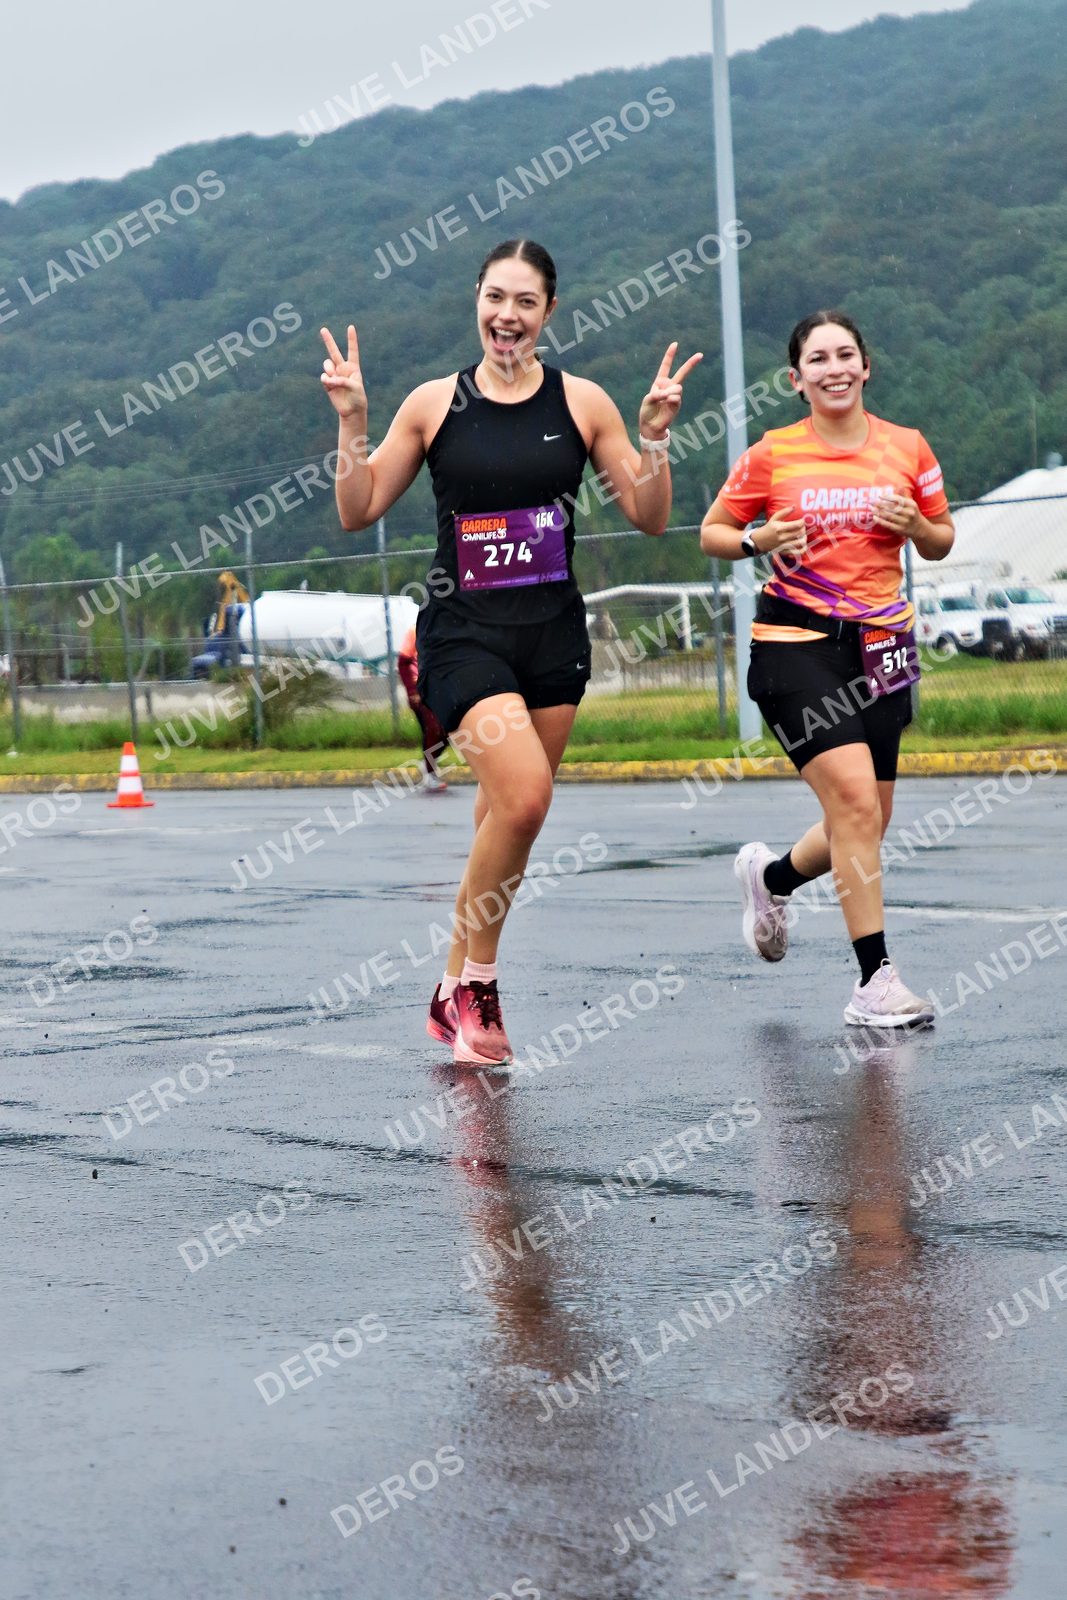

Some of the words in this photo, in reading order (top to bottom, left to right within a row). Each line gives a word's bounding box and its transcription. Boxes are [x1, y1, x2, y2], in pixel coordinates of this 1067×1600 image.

[462, 518, 507, 533] CARRERA
[462, 531, 497, 541] OMNILIFE
[483, 541, 533, 567] 274
[882, 647, 907, 673] 512
